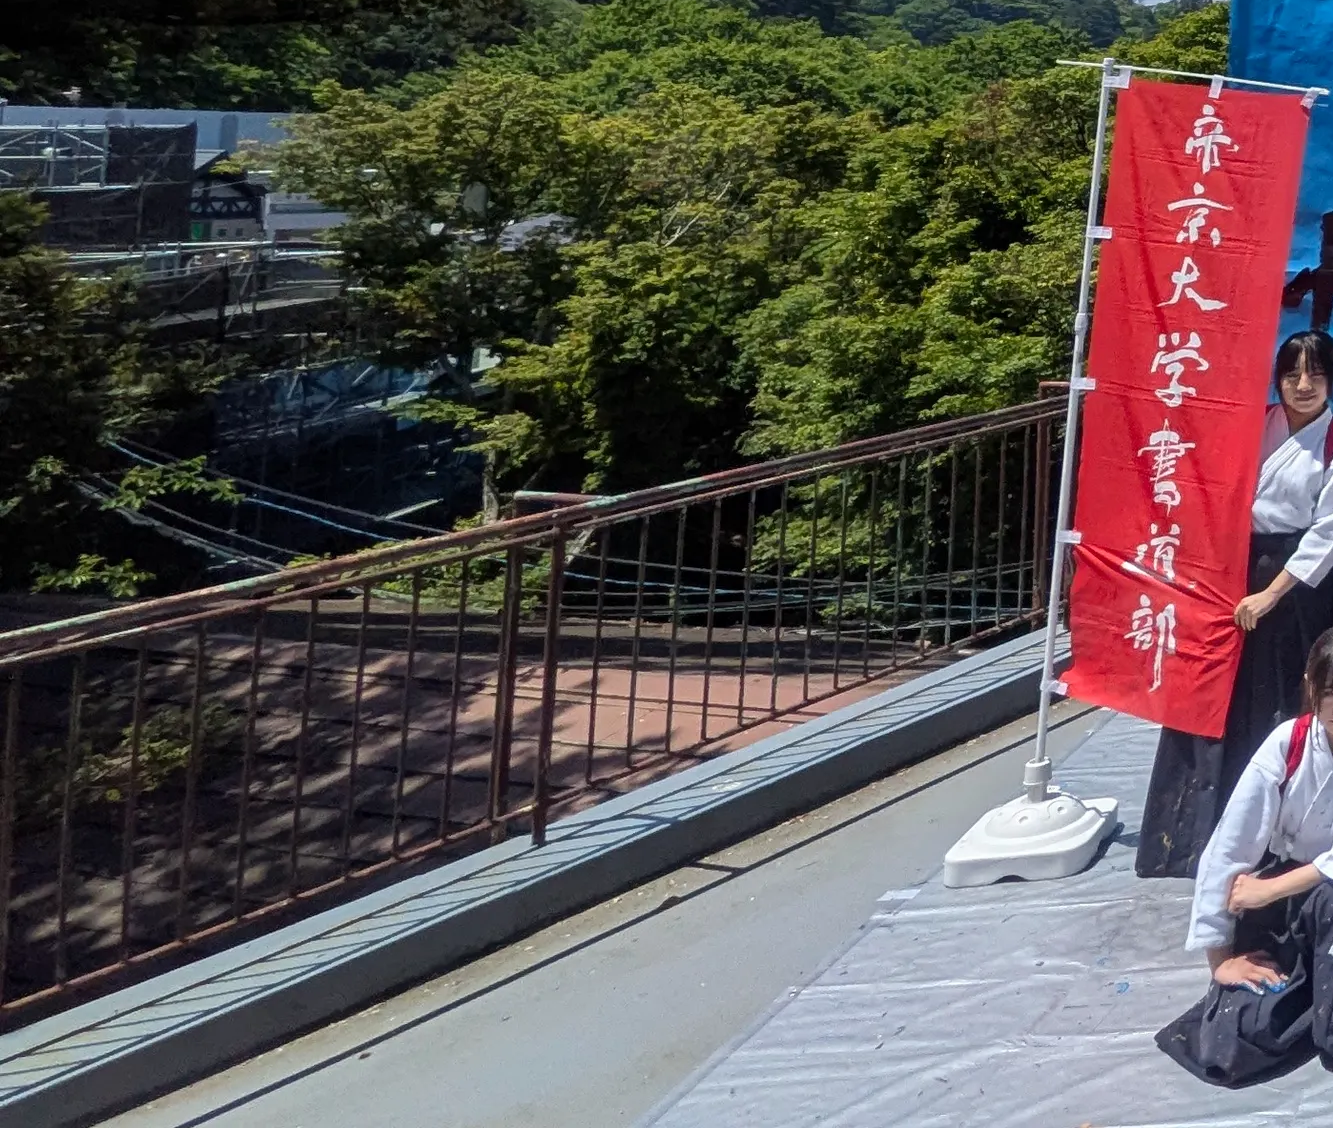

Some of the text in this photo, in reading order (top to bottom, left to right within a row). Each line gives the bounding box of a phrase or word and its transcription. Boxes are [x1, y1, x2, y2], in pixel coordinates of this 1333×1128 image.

[1121, 104, 1240, 694] 帝京大学書道部
